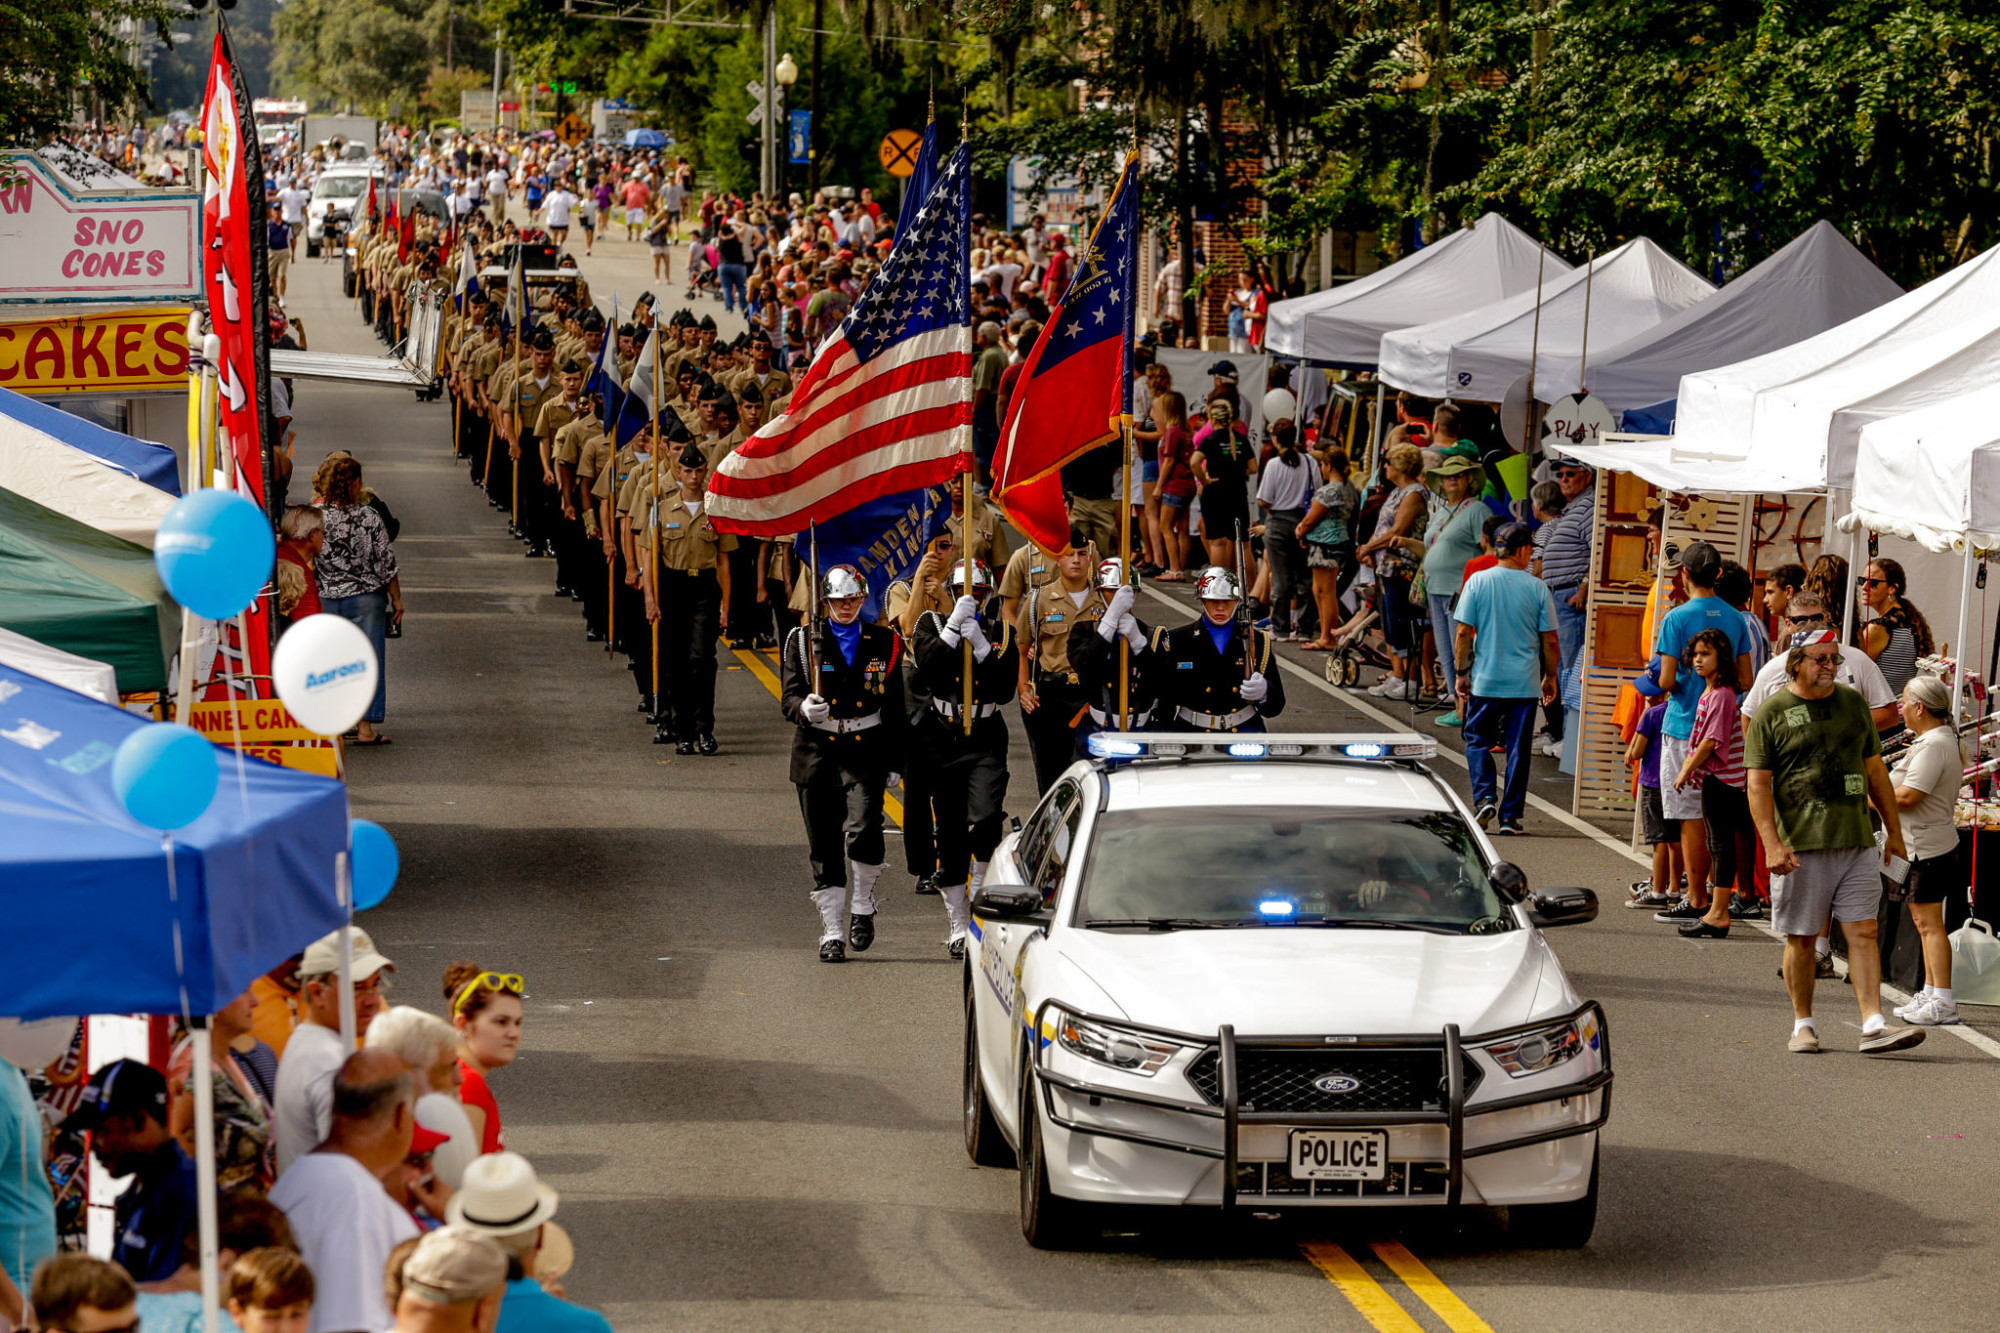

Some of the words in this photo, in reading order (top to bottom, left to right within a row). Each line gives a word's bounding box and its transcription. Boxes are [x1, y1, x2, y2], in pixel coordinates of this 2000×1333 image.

[884, 146, 893, 158] R
[74, 217, 144, 246] SNO
[61, 248, 165, 279] CONES
[0, 321, 188, 382] CAKES
[1554, 419, 1600, 439] PLAY
[858, 503, 920, 574] AMDEN
[193, 709, 249, 733] NNEL
[1325, 1079, 1350, 1091] Ford
[1299, 1139, 1378, 1168] POLICE
